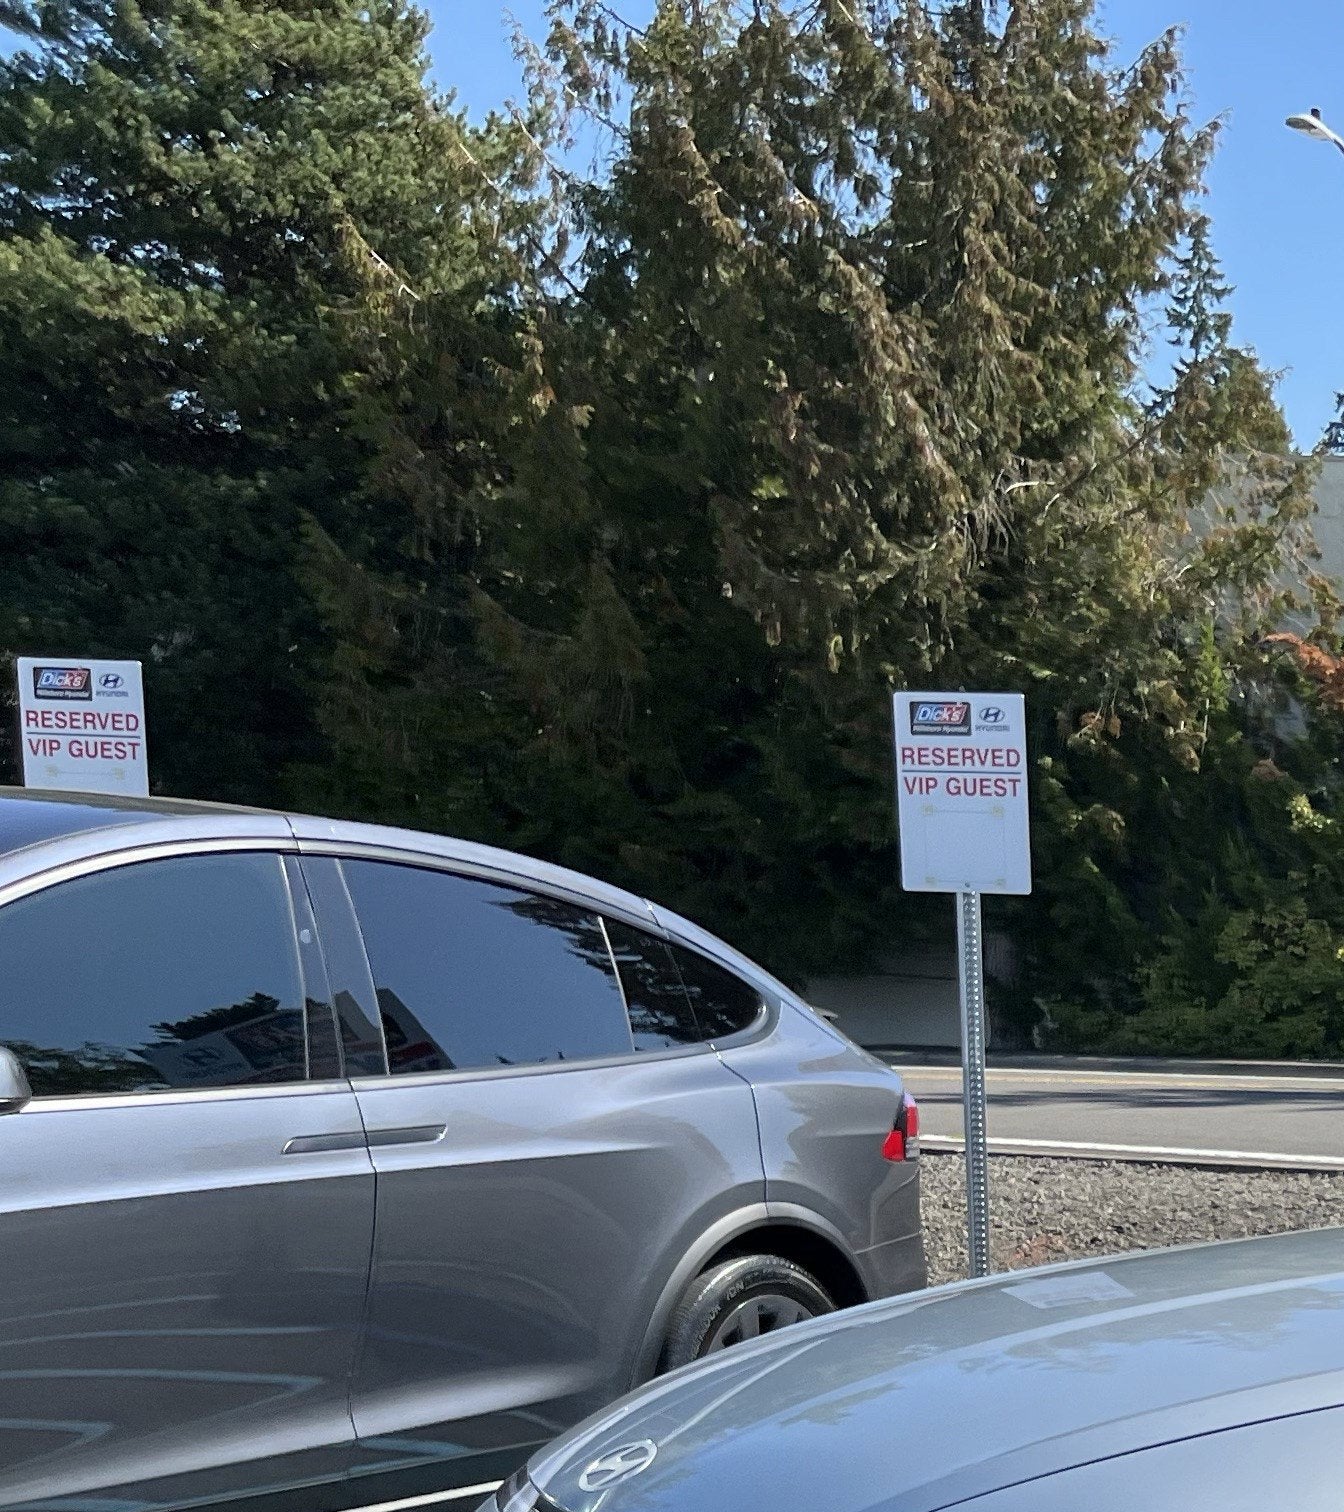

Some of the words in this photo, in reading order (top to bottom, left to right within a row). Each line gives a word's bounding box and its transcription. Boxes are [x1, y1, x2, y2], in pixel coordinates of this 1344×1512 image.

[25, 709, 139, 732] RESERVED
[28, 738, 61, 758] VIP
[68, 739, 140, 760] GUEST
[902, 747, 1021, 768] RESERVED
[904, 776, 938, 796] VIP
[946, 777, 1021, 798] GUEST
